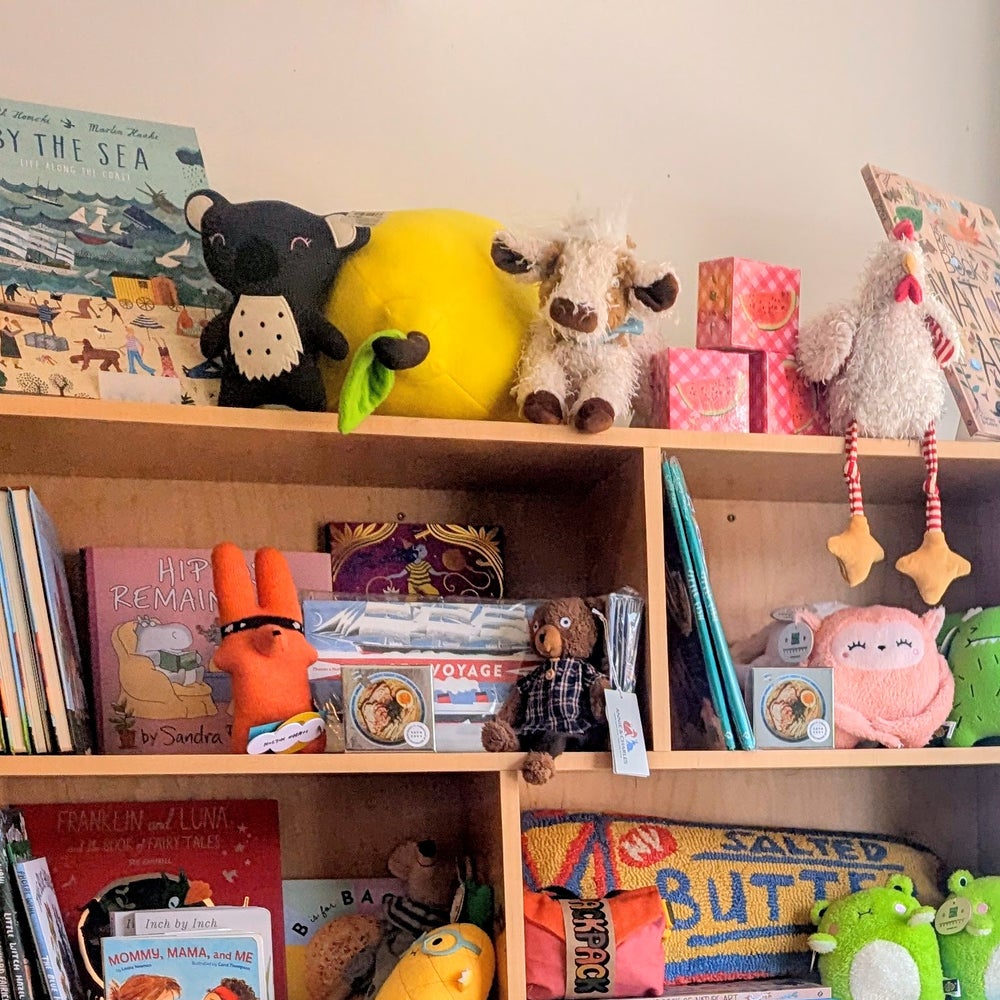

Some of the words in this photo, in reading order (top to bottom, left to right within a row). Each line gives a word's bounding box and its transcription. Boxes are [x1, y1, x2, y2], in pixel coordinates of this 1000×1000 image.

[34, 133, 83, 162] THE
[98, 142, 148, 171] SEA
[45, 162, 76, 174] ALONG
[102, 171, 130, 182] COAST
[432, 664, 502, 679] VOYAGE
[141, 728, 157, 746] by
[160, 726, 222, 746] Sandra
[57, 810, 144, 832] FRANKLIN
[180, 807, 228, 830] LUNA
[181, 835, 220, 849] TALES
[722, 831, 888, 862] SALTED
[656, 868, 876, 931] BUTTE
[3, 912, 16, 938] LITTLE
[146, 919, 170, 929] Inch
[175, 919, 188, 930] by
[192, 918, 217, 928] Inch
[292, 922, 309, 937] B
[9, 942, 21, 971] WITCH
[108, 948, 164, 966] MOMMY,
[167, 947, 210, 959] MAMA,
[214, 951, 231, 960] and
[235, 951, 253, 963] ME
[41, 954, 51, 970] THE
[47, 973, 58, 992] BLUE
[15, 974, 26, 1000] HAZEL
